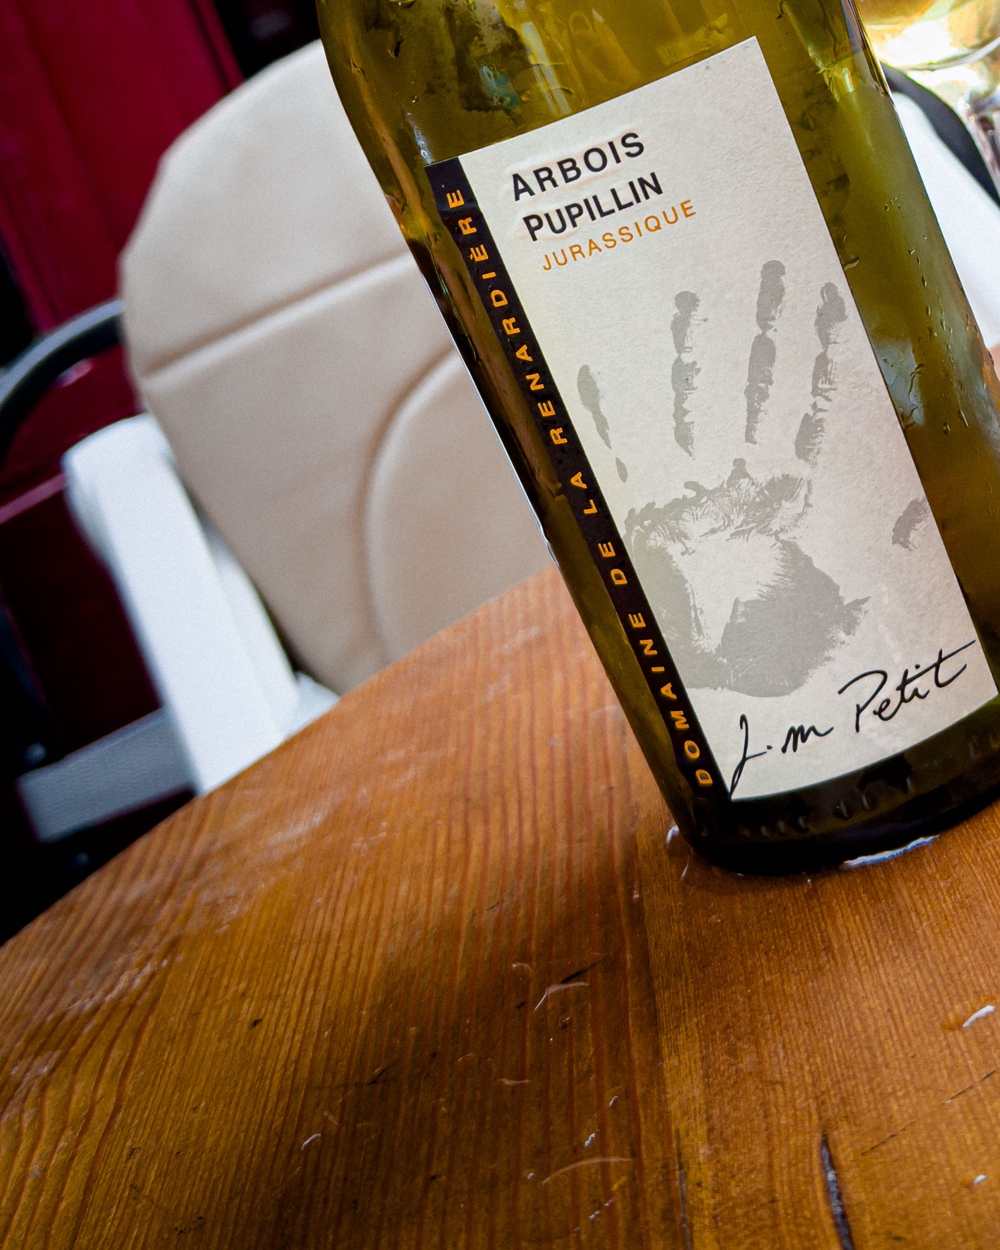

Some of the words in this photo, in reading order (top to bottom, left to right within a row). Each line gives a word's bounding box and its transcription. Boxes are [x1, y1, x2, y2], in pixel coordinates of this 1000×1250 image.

[510, 131, 646, 202] ARBOIS
[522, 171, 664, 242] PUPILLIN
[541, 199, 697, 271] JURASSIQUE
[445, 188, 569, 447] RENARDIÈRE
[570, 471, 599, 516] LA
[598, 538, 629, 587] DE
[629, 611, 714, 787] DOMAINE
[837, 639, 977, 734] Petit
